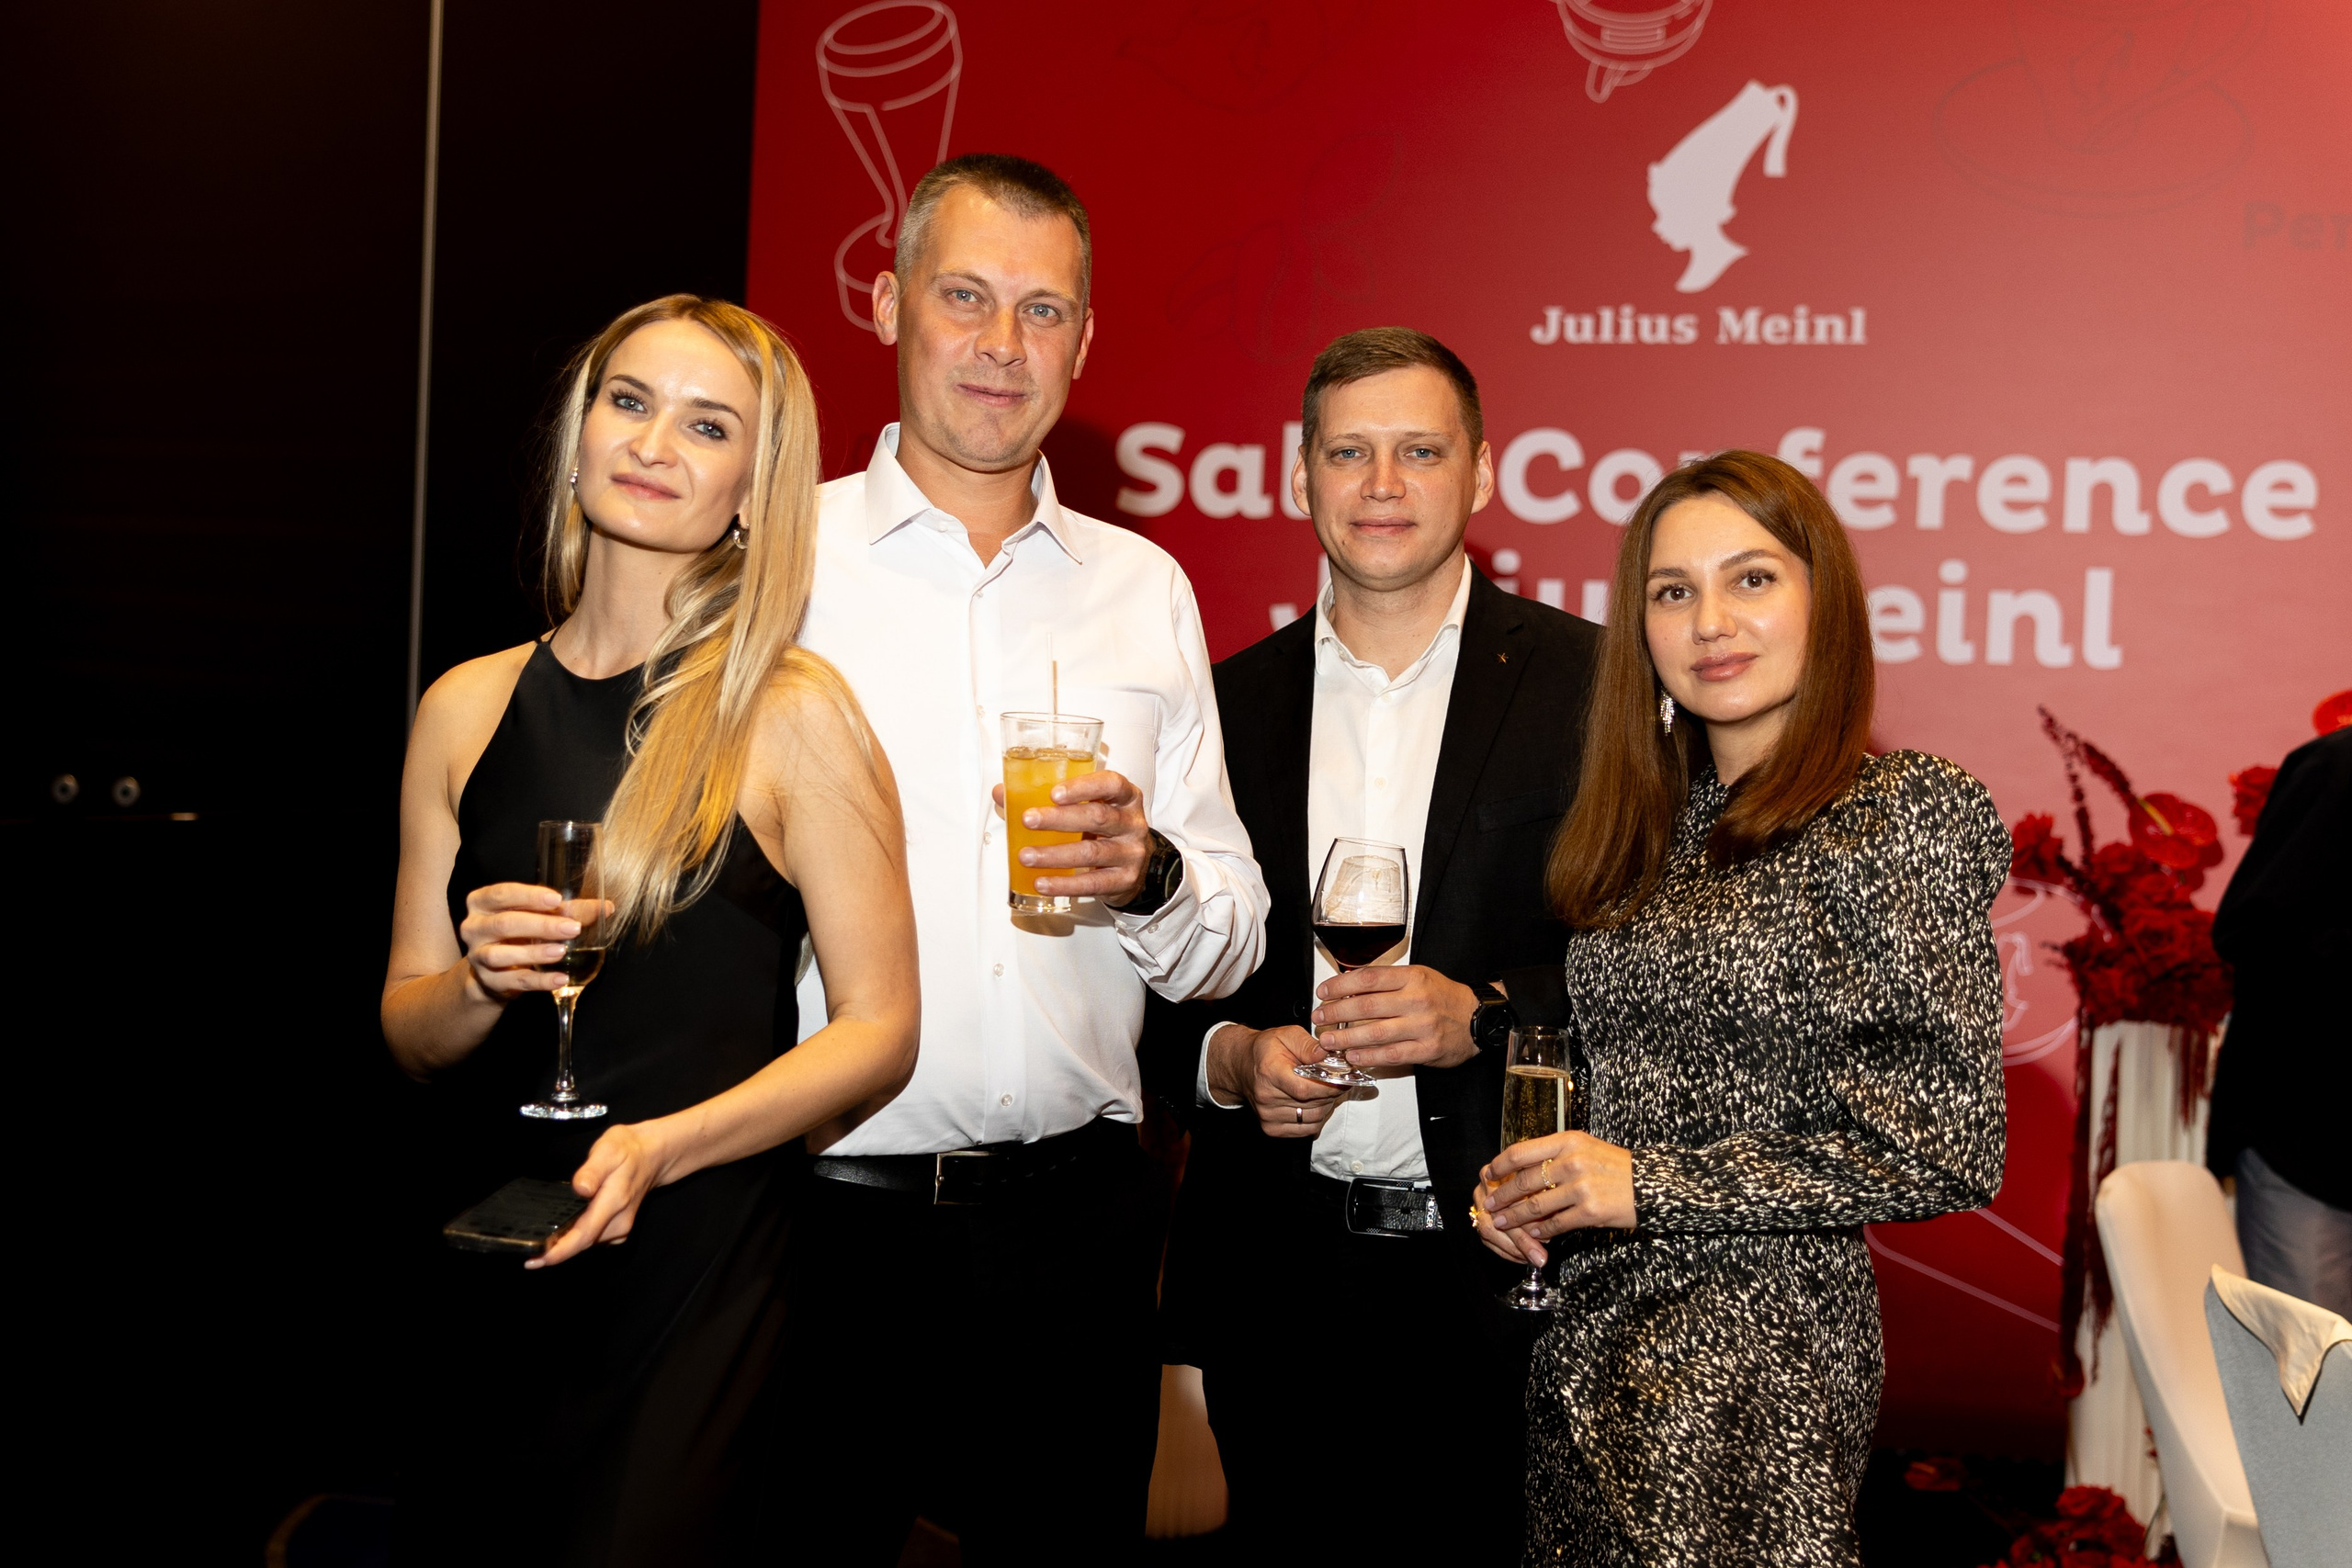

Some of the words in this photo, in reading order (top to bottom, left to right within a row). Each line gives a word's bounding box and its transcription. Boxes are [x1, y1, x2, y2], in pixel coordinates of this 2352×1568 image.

[1529, 303, 1700, 346] Julius
[1715, 304, 1869, 346] Meinl
[1114, 420, 1312, 521] Sal
[1499, 426, 2320, 540] Coference
[1868, 558, 2124, 670] einl
